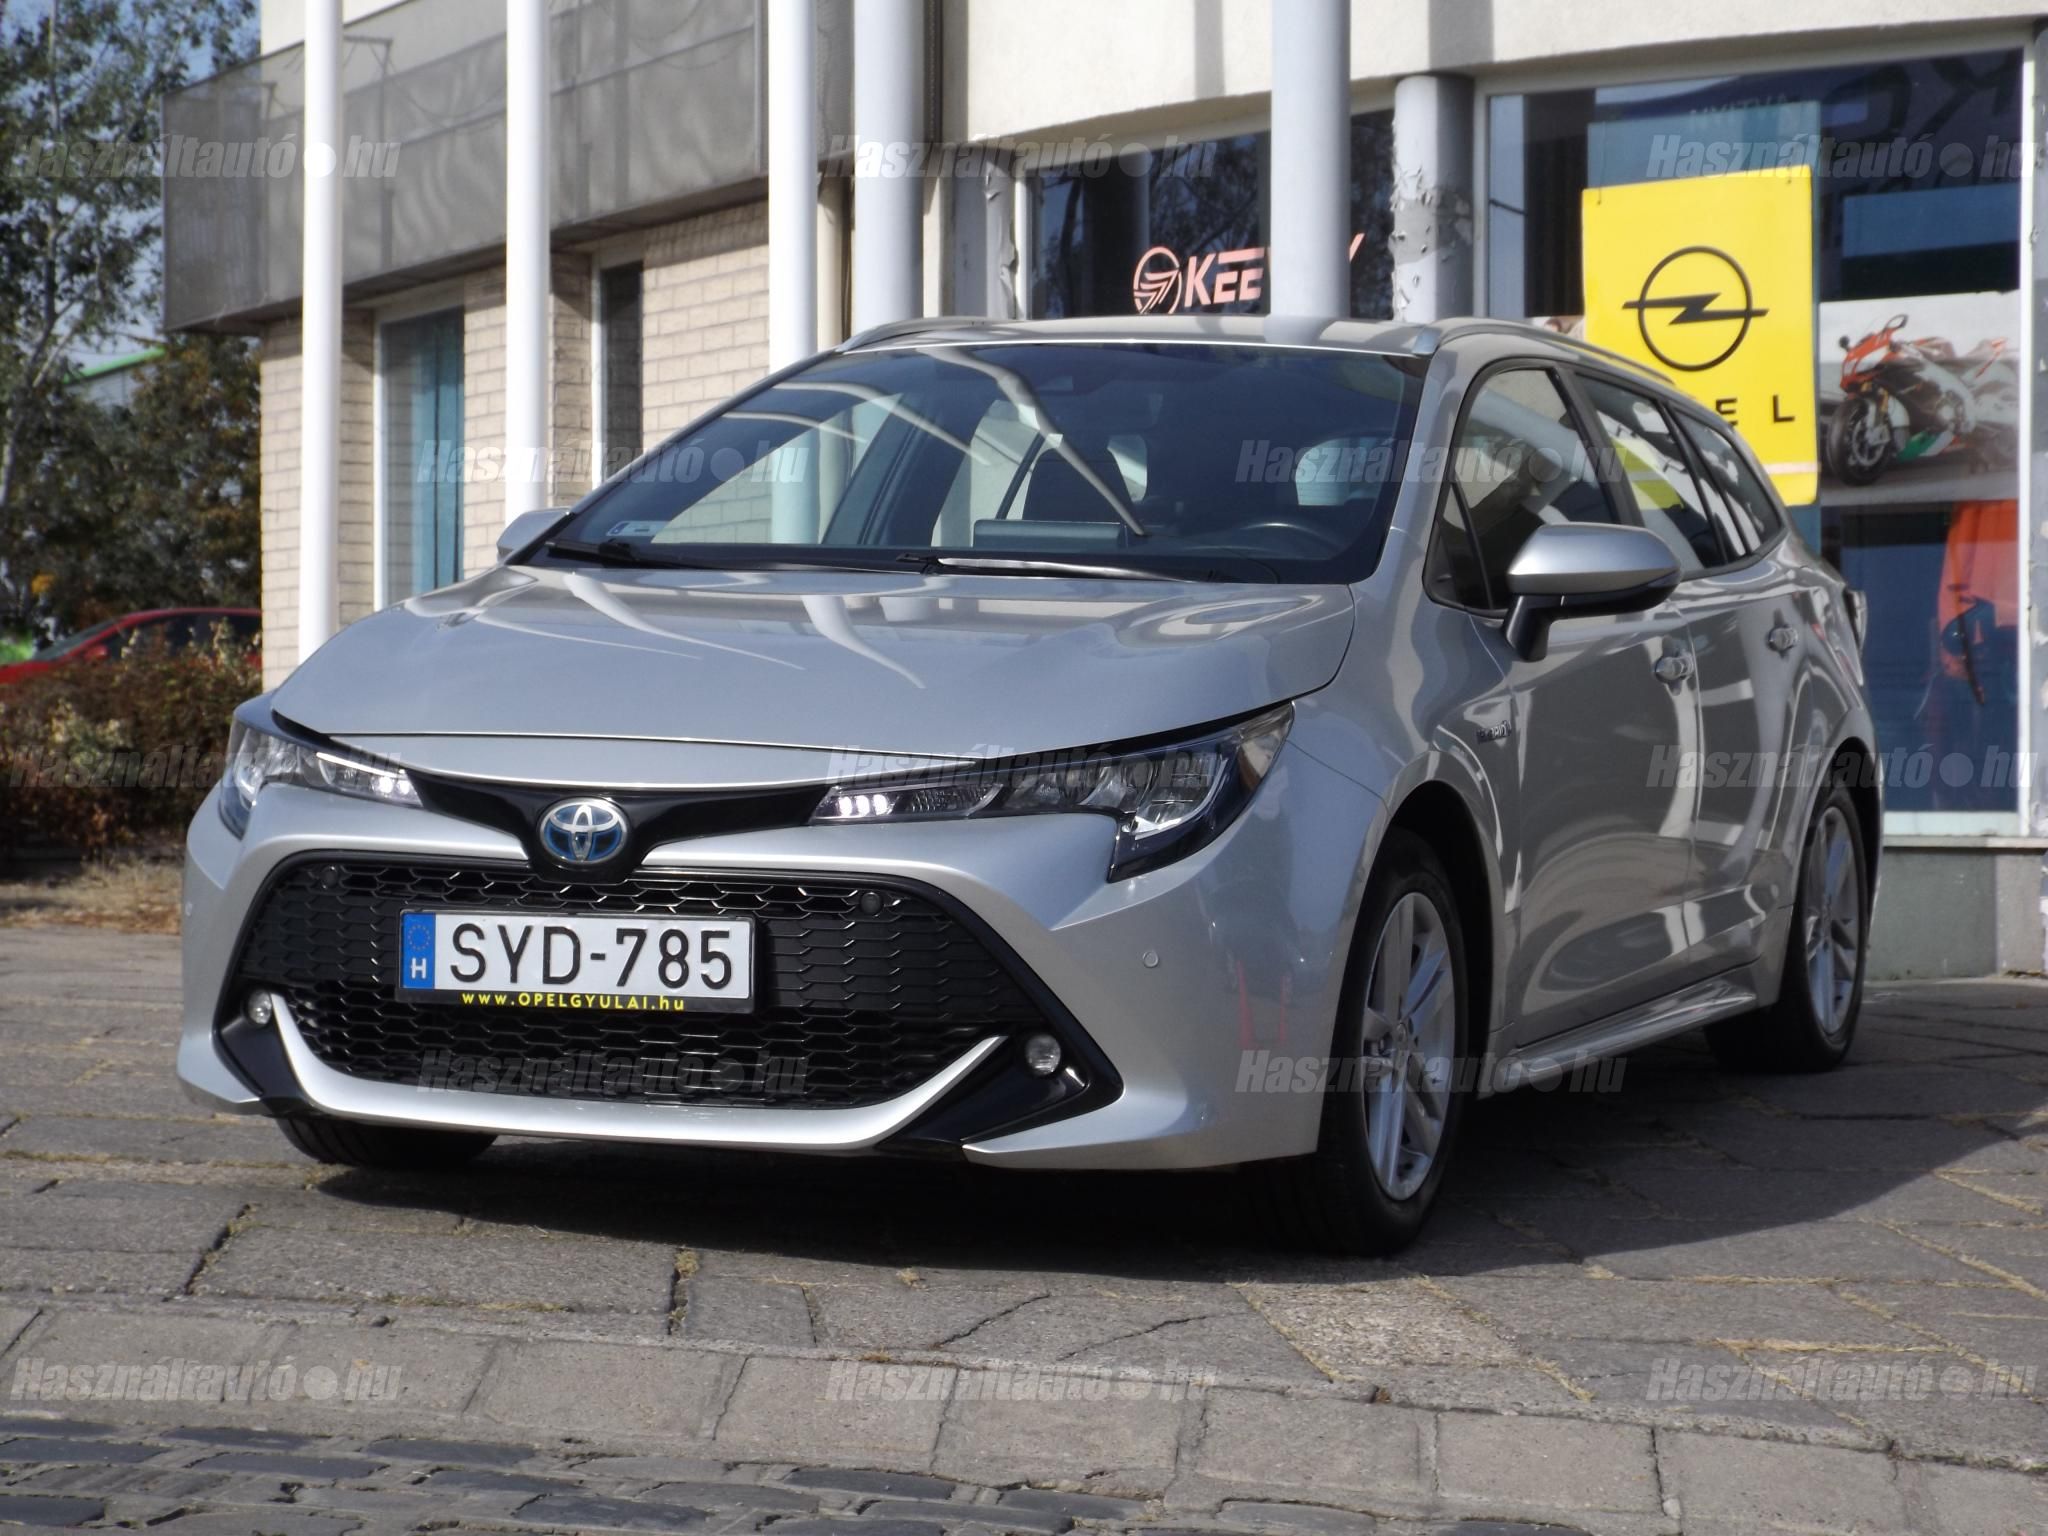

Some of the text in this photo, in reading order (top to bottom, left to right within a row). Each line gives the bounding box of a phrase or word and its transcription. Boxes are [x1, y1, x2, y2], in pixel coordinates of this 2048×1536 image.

[449, 922, 732, 990] SYD-785
[410, 957, 428, 980] H
[461, 992, 685, 1011] www.OPELGYULAI.hu
